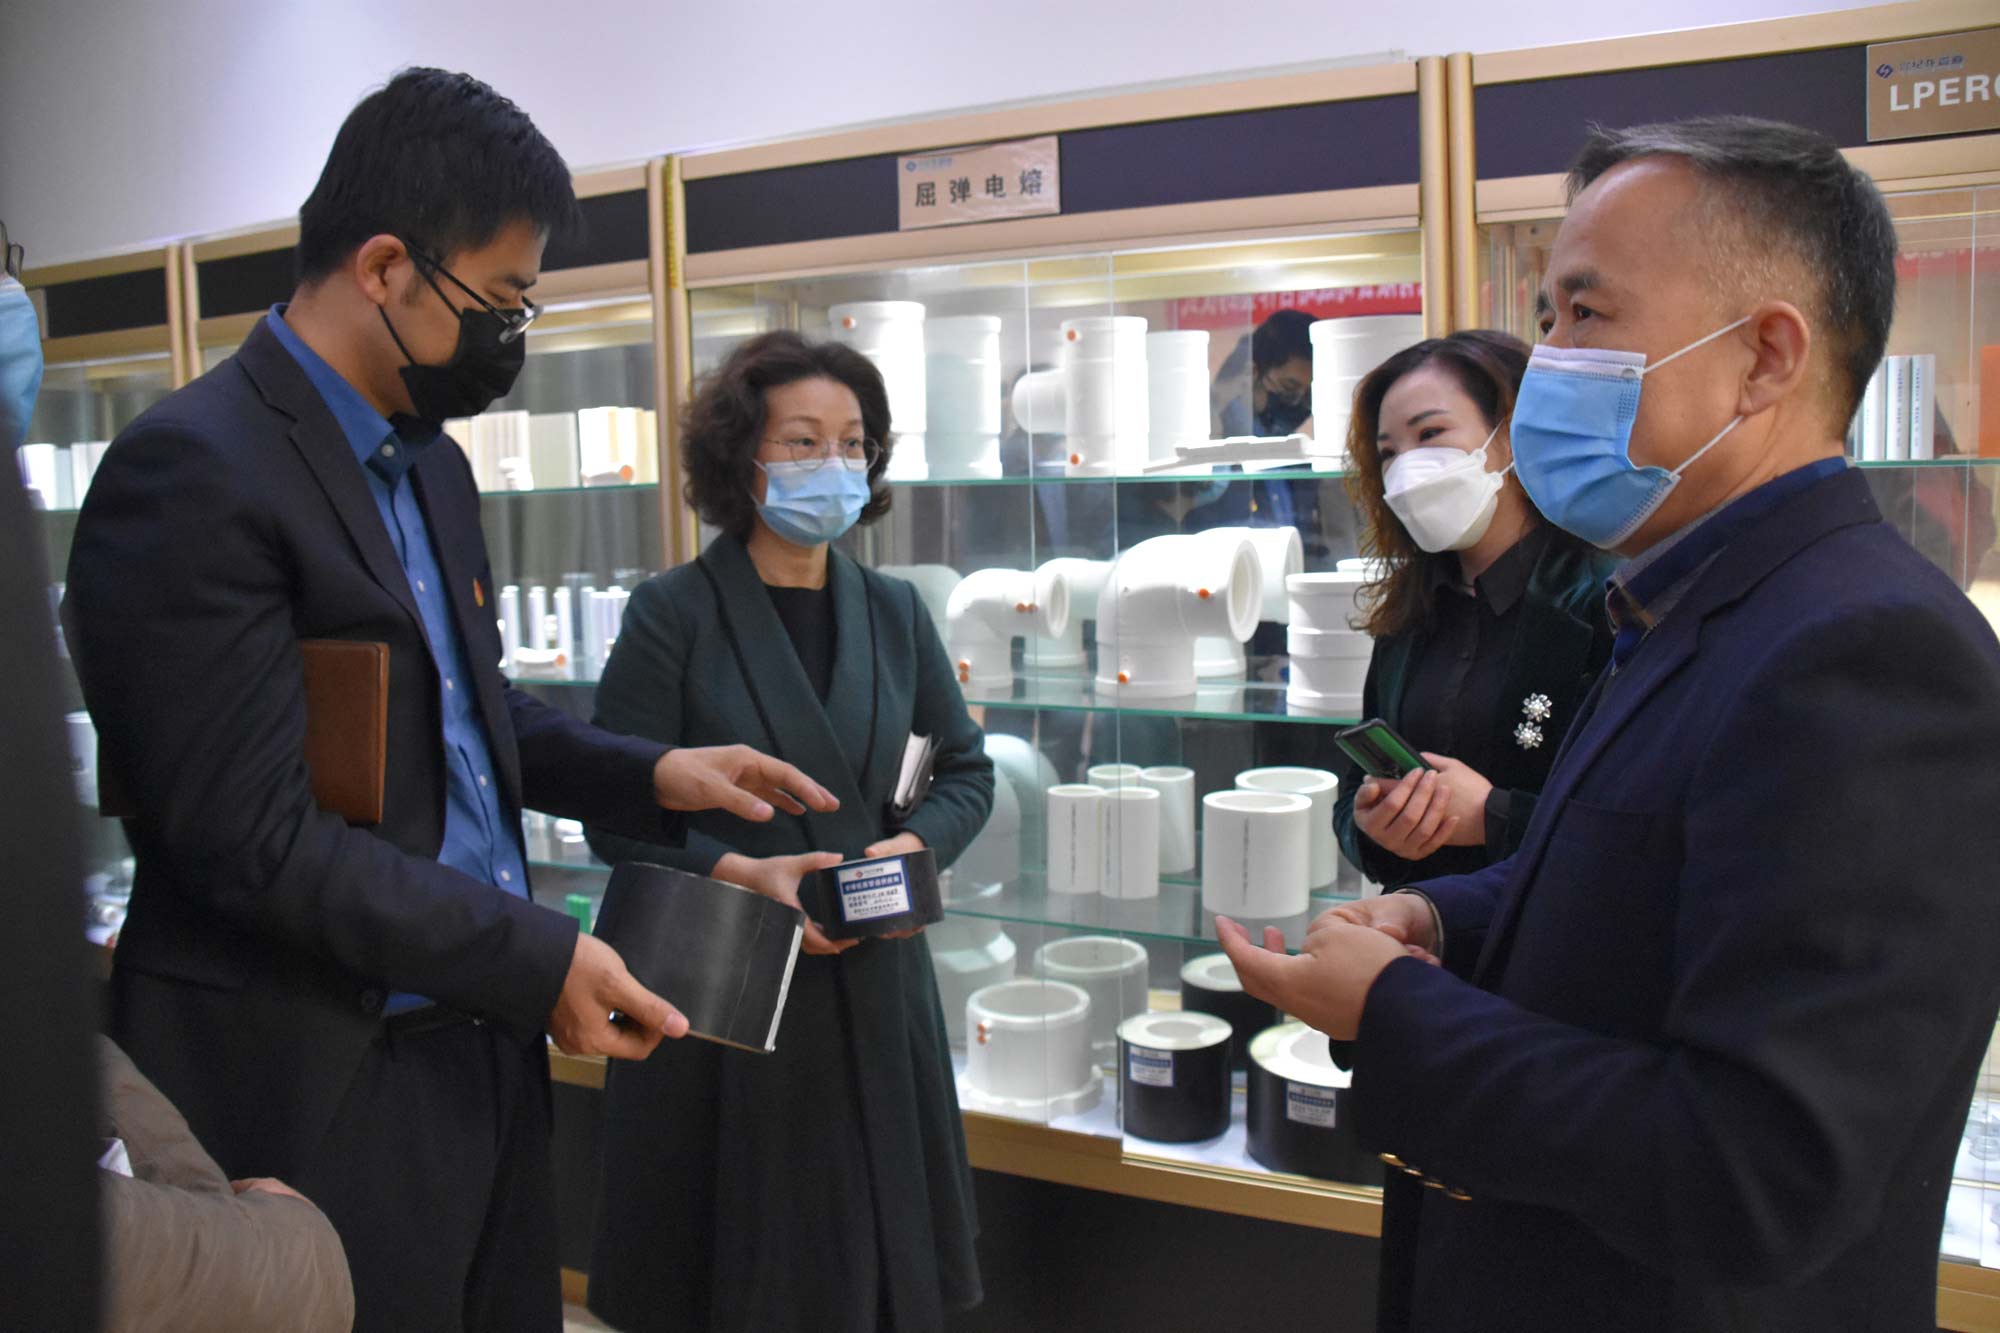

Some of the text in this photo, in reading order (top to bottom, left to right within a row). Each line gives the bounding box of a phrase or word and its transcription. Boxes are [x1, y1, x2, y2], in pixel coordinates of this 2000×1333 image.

[1889, 74, 2000, 112] LPER
[915, 167, 1043, 207] 屈弹电熔
